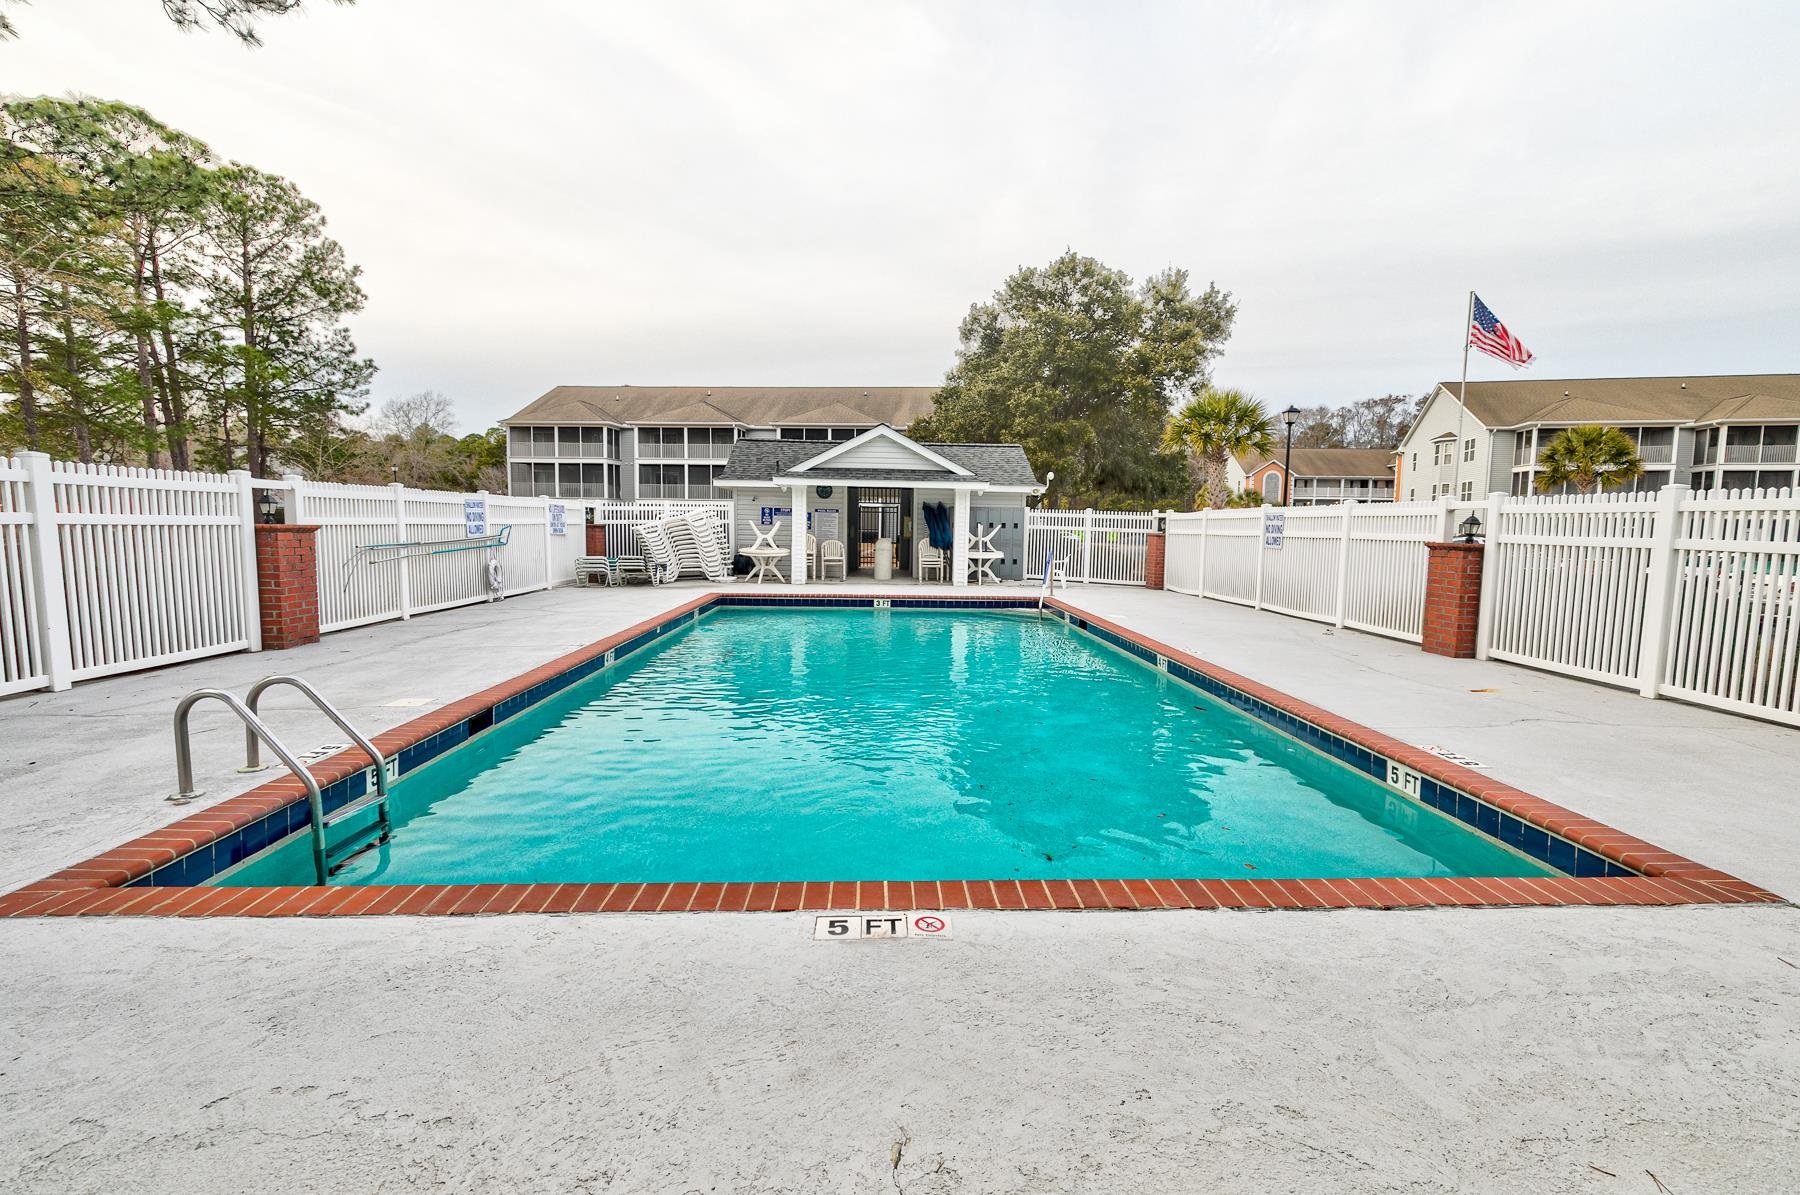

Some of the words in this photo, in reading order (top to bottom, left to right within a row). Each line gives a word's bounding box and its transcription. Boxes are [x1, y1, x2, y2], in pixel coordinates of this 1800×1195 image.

[466, 512, 471, 522] NO
[472, 512, 484, 522] DIVING
[468, 524, 484, 534] ALLOWED
[1271, 524, 1283, 534] DIVING
[1265, 536, 1281, 546] ALLOWED
[1391, 765, 1399, 784] 5
[1404, 772, 1419, 794] FT
[827, 919, 849, 936] 5
[866, 918, 902, 935] FT
